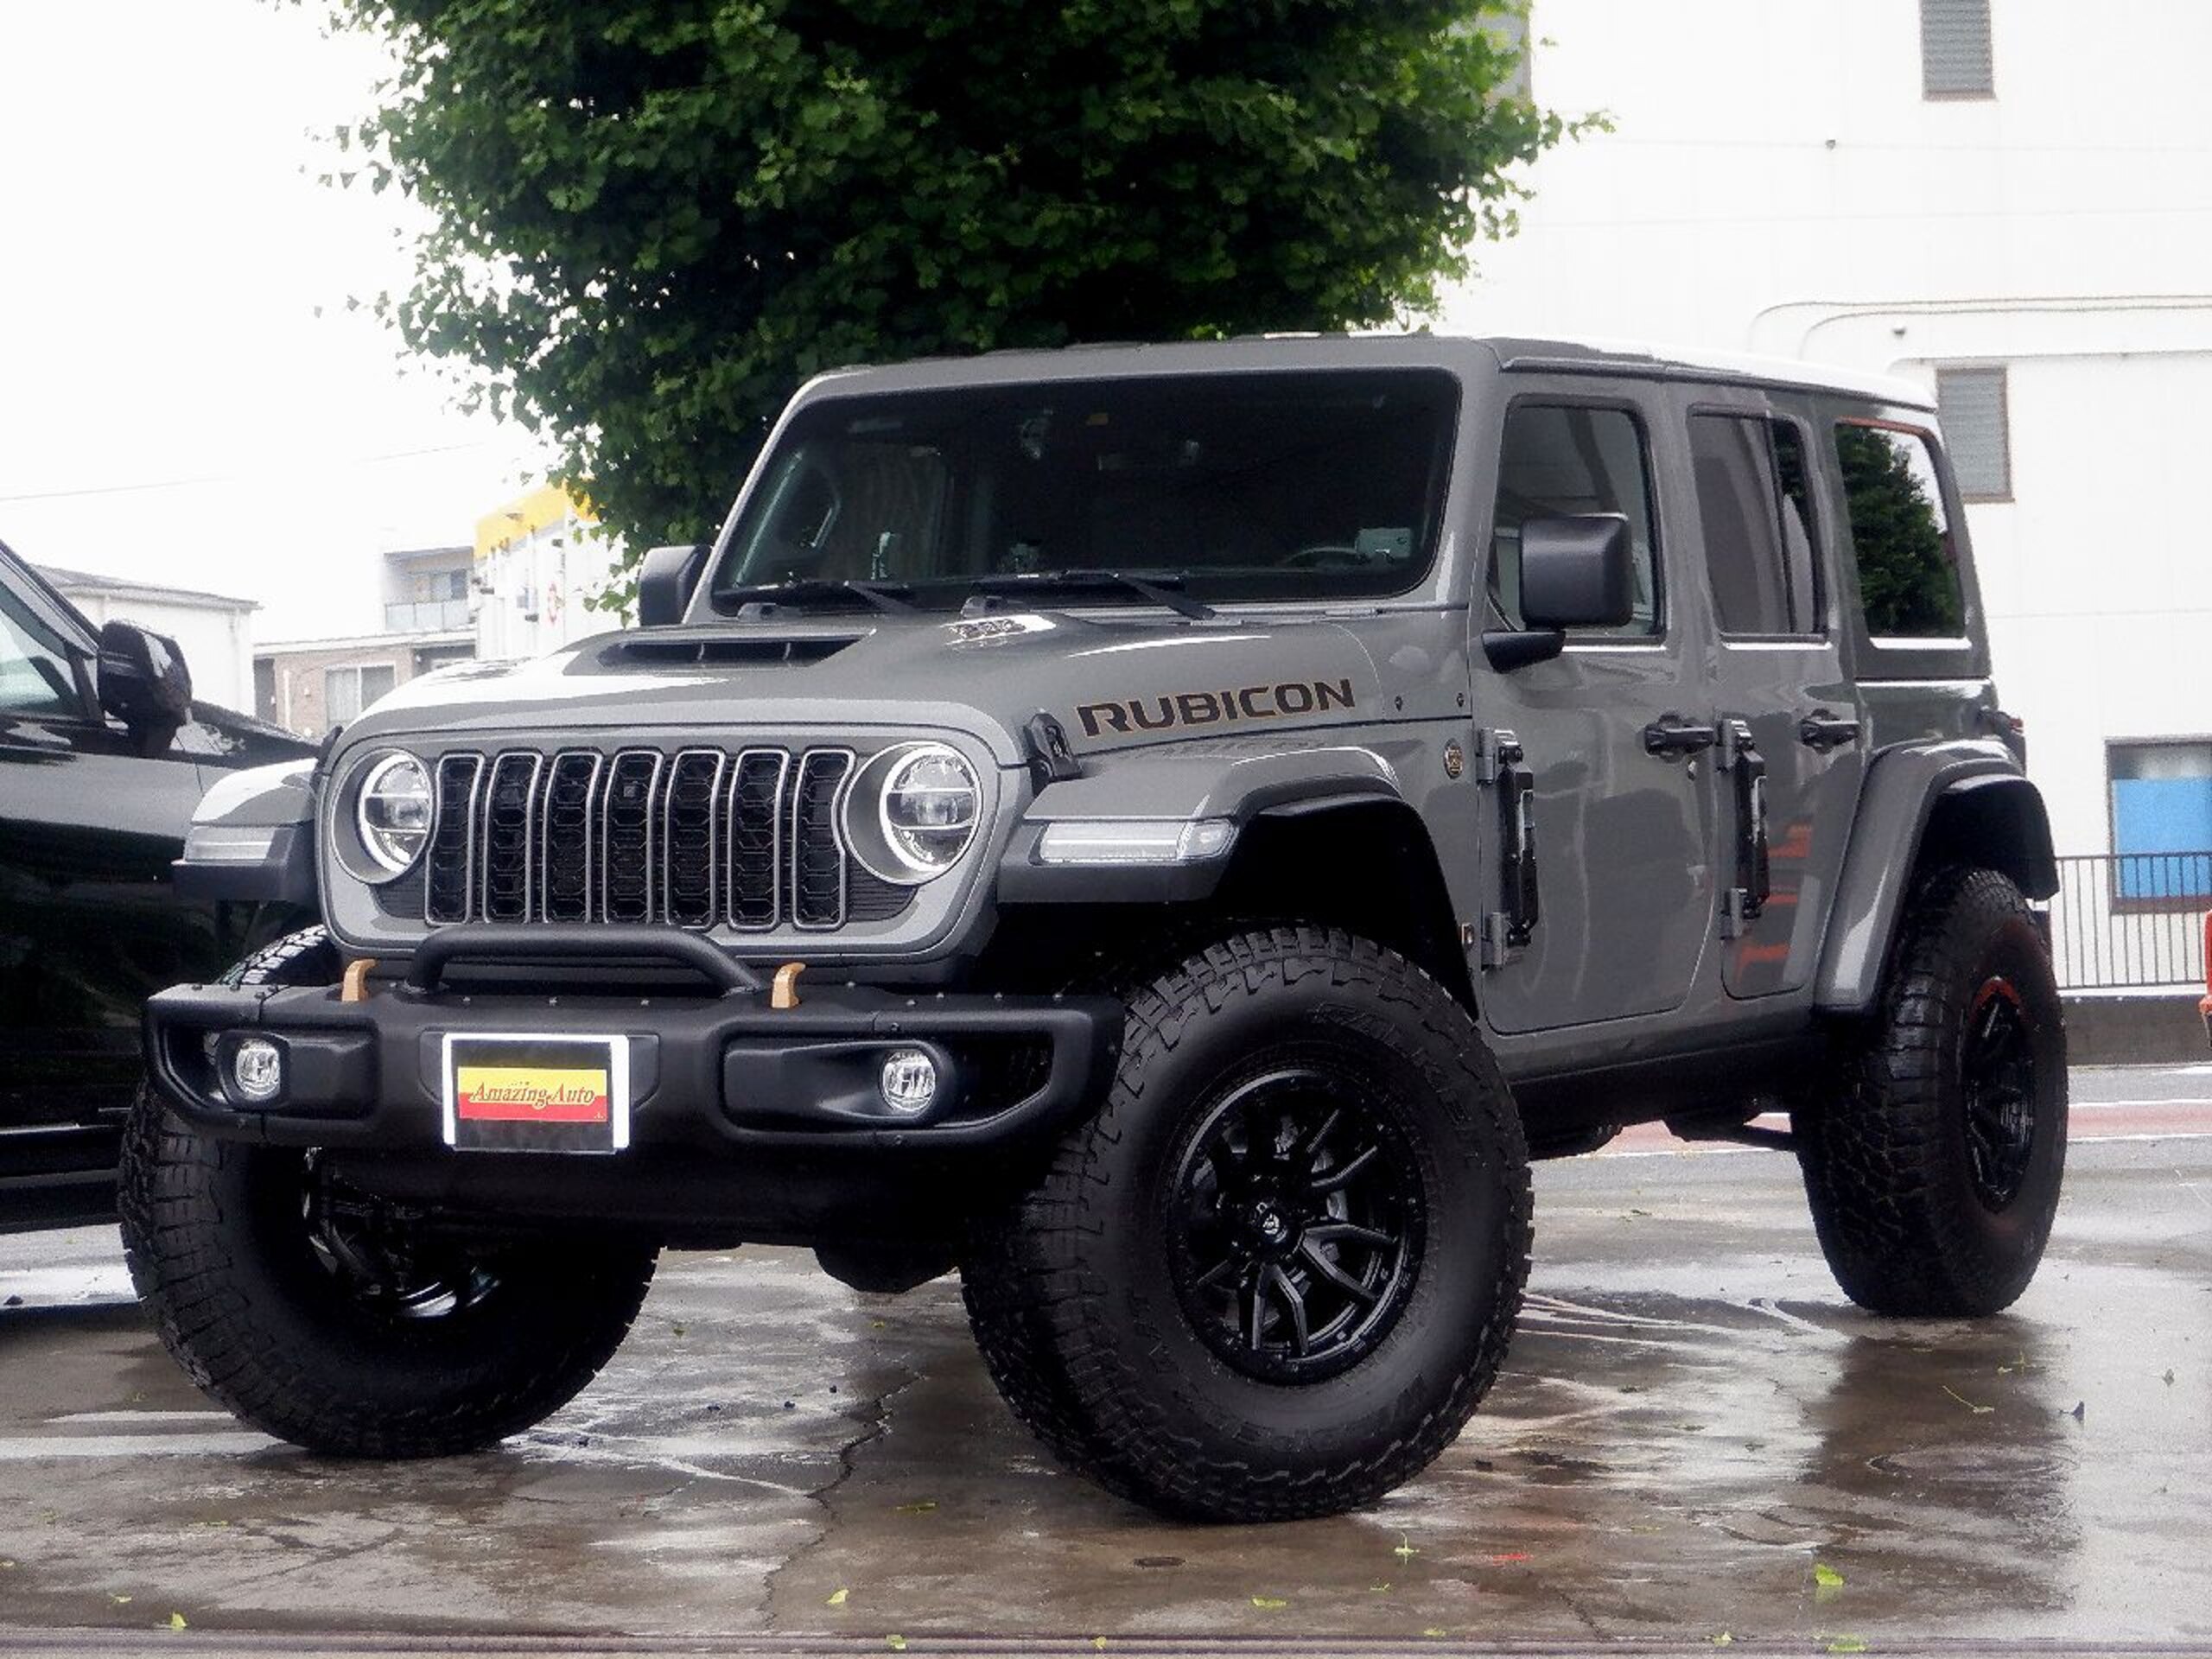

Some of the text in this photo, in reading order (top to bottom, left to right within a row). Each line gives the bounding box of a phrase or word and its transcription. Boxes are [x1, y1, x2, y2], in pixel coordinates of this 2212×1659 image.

[1077, 679, 1355, 737] RUBICON
[470, 1082, 595, 1107] Amazing Auto
